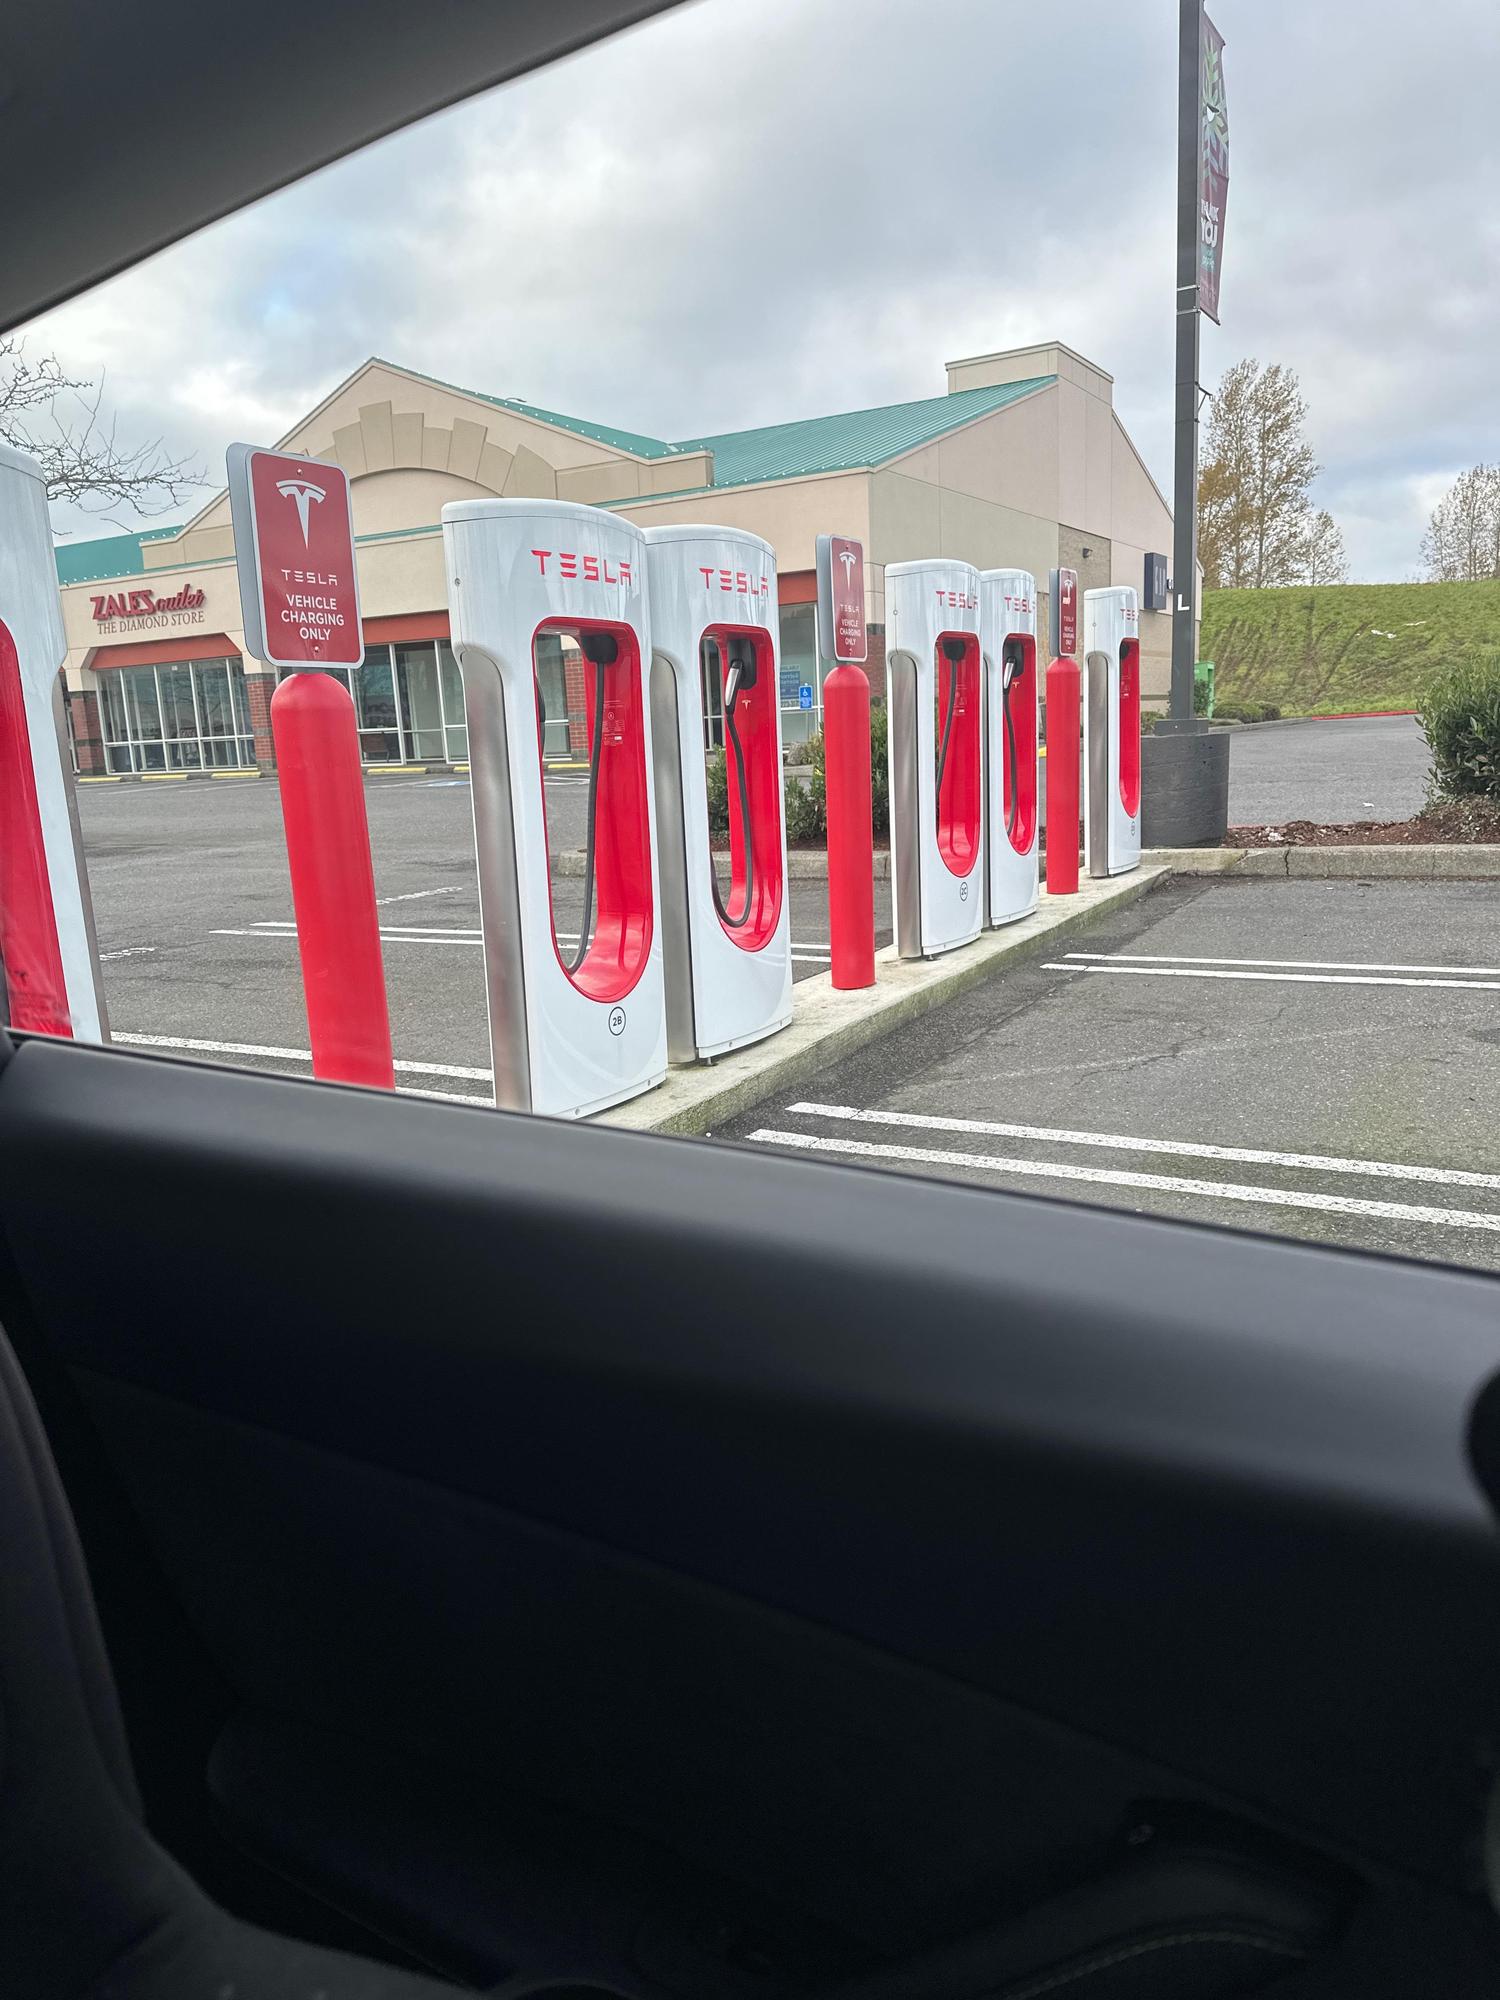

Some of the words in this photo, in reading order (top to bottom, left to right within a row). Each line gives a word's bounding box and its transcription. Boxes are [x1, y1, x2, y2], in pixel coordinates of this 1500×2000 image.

[281, 569, 338, 586] TESLA
[531, 550, 631, 586] TESLA
[699, 568, 768, 597] TESLA
[90, 589, 155, 620] ZALES
[155, 583, 205, 611] outlet
[286, 593, 338, 610] VEHICLE
[97, 622, 117, 634] THE
[120, 614, 168, 633] DIAMOND
[171, 611, 205, 626] STORE
[281, 610, 345, 626] CHARGING
[300, 627, 331, 641] ONLY
